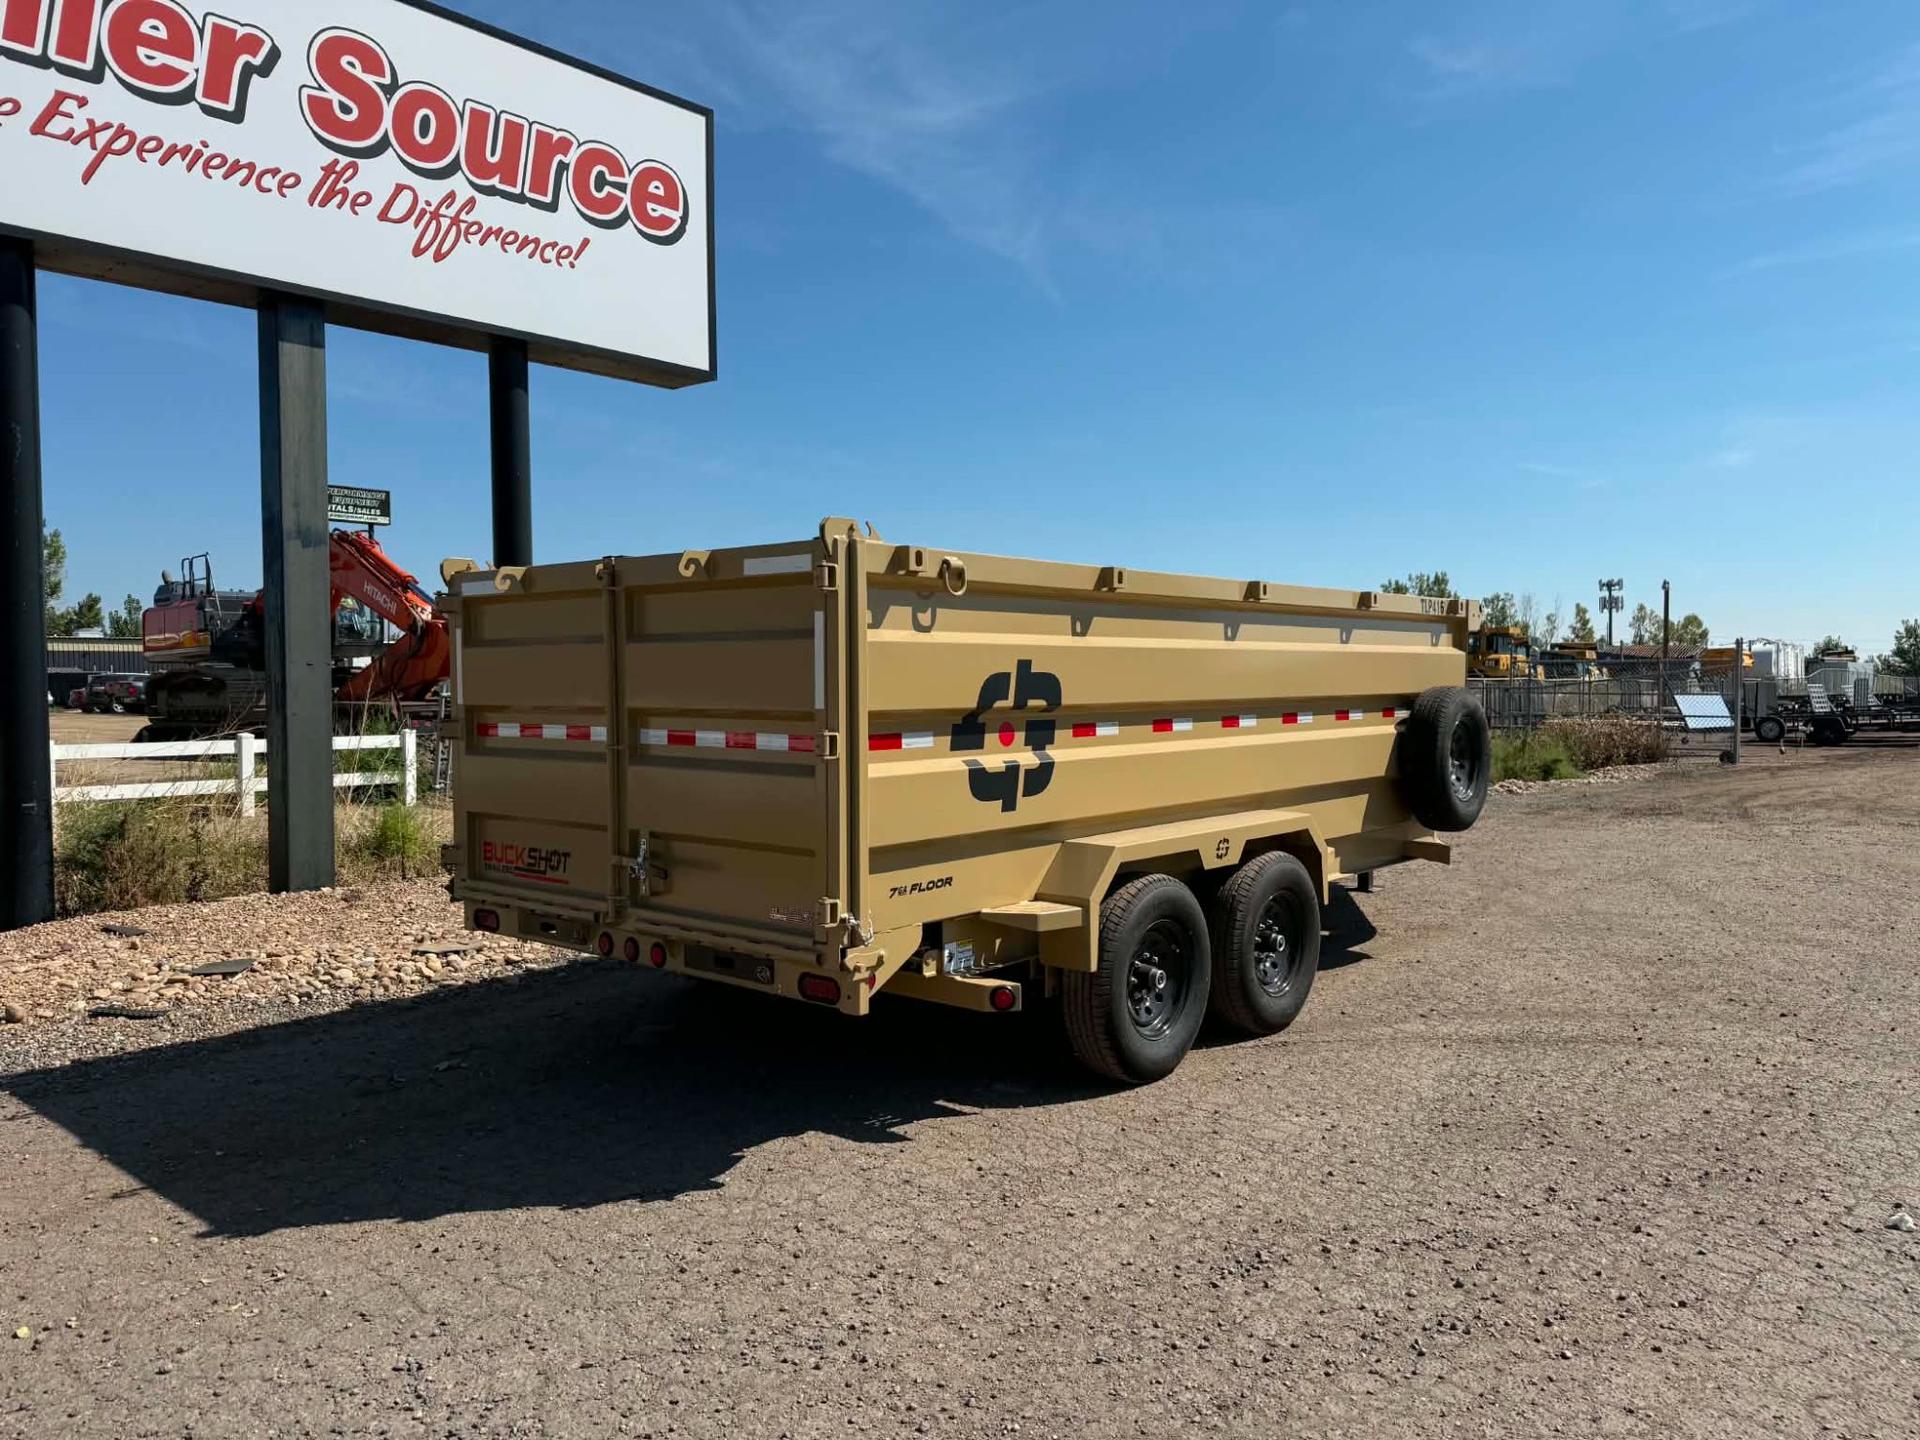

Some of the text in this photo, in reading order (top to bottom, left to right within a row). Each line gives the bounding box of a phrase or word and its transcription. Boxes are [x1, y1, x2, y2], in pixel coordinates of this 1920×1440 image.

[299, 26, 690, 246] Source
[29, 89, 302, 198] Experience
[308, 158, 373, 216] the
[376, 182, 591, 269] Difference!
[364, 580, 397, 615] HITACHI
[482, 841, 571, 875] BUCKSHOT
[909, 876, 953, 895] FLOOR
